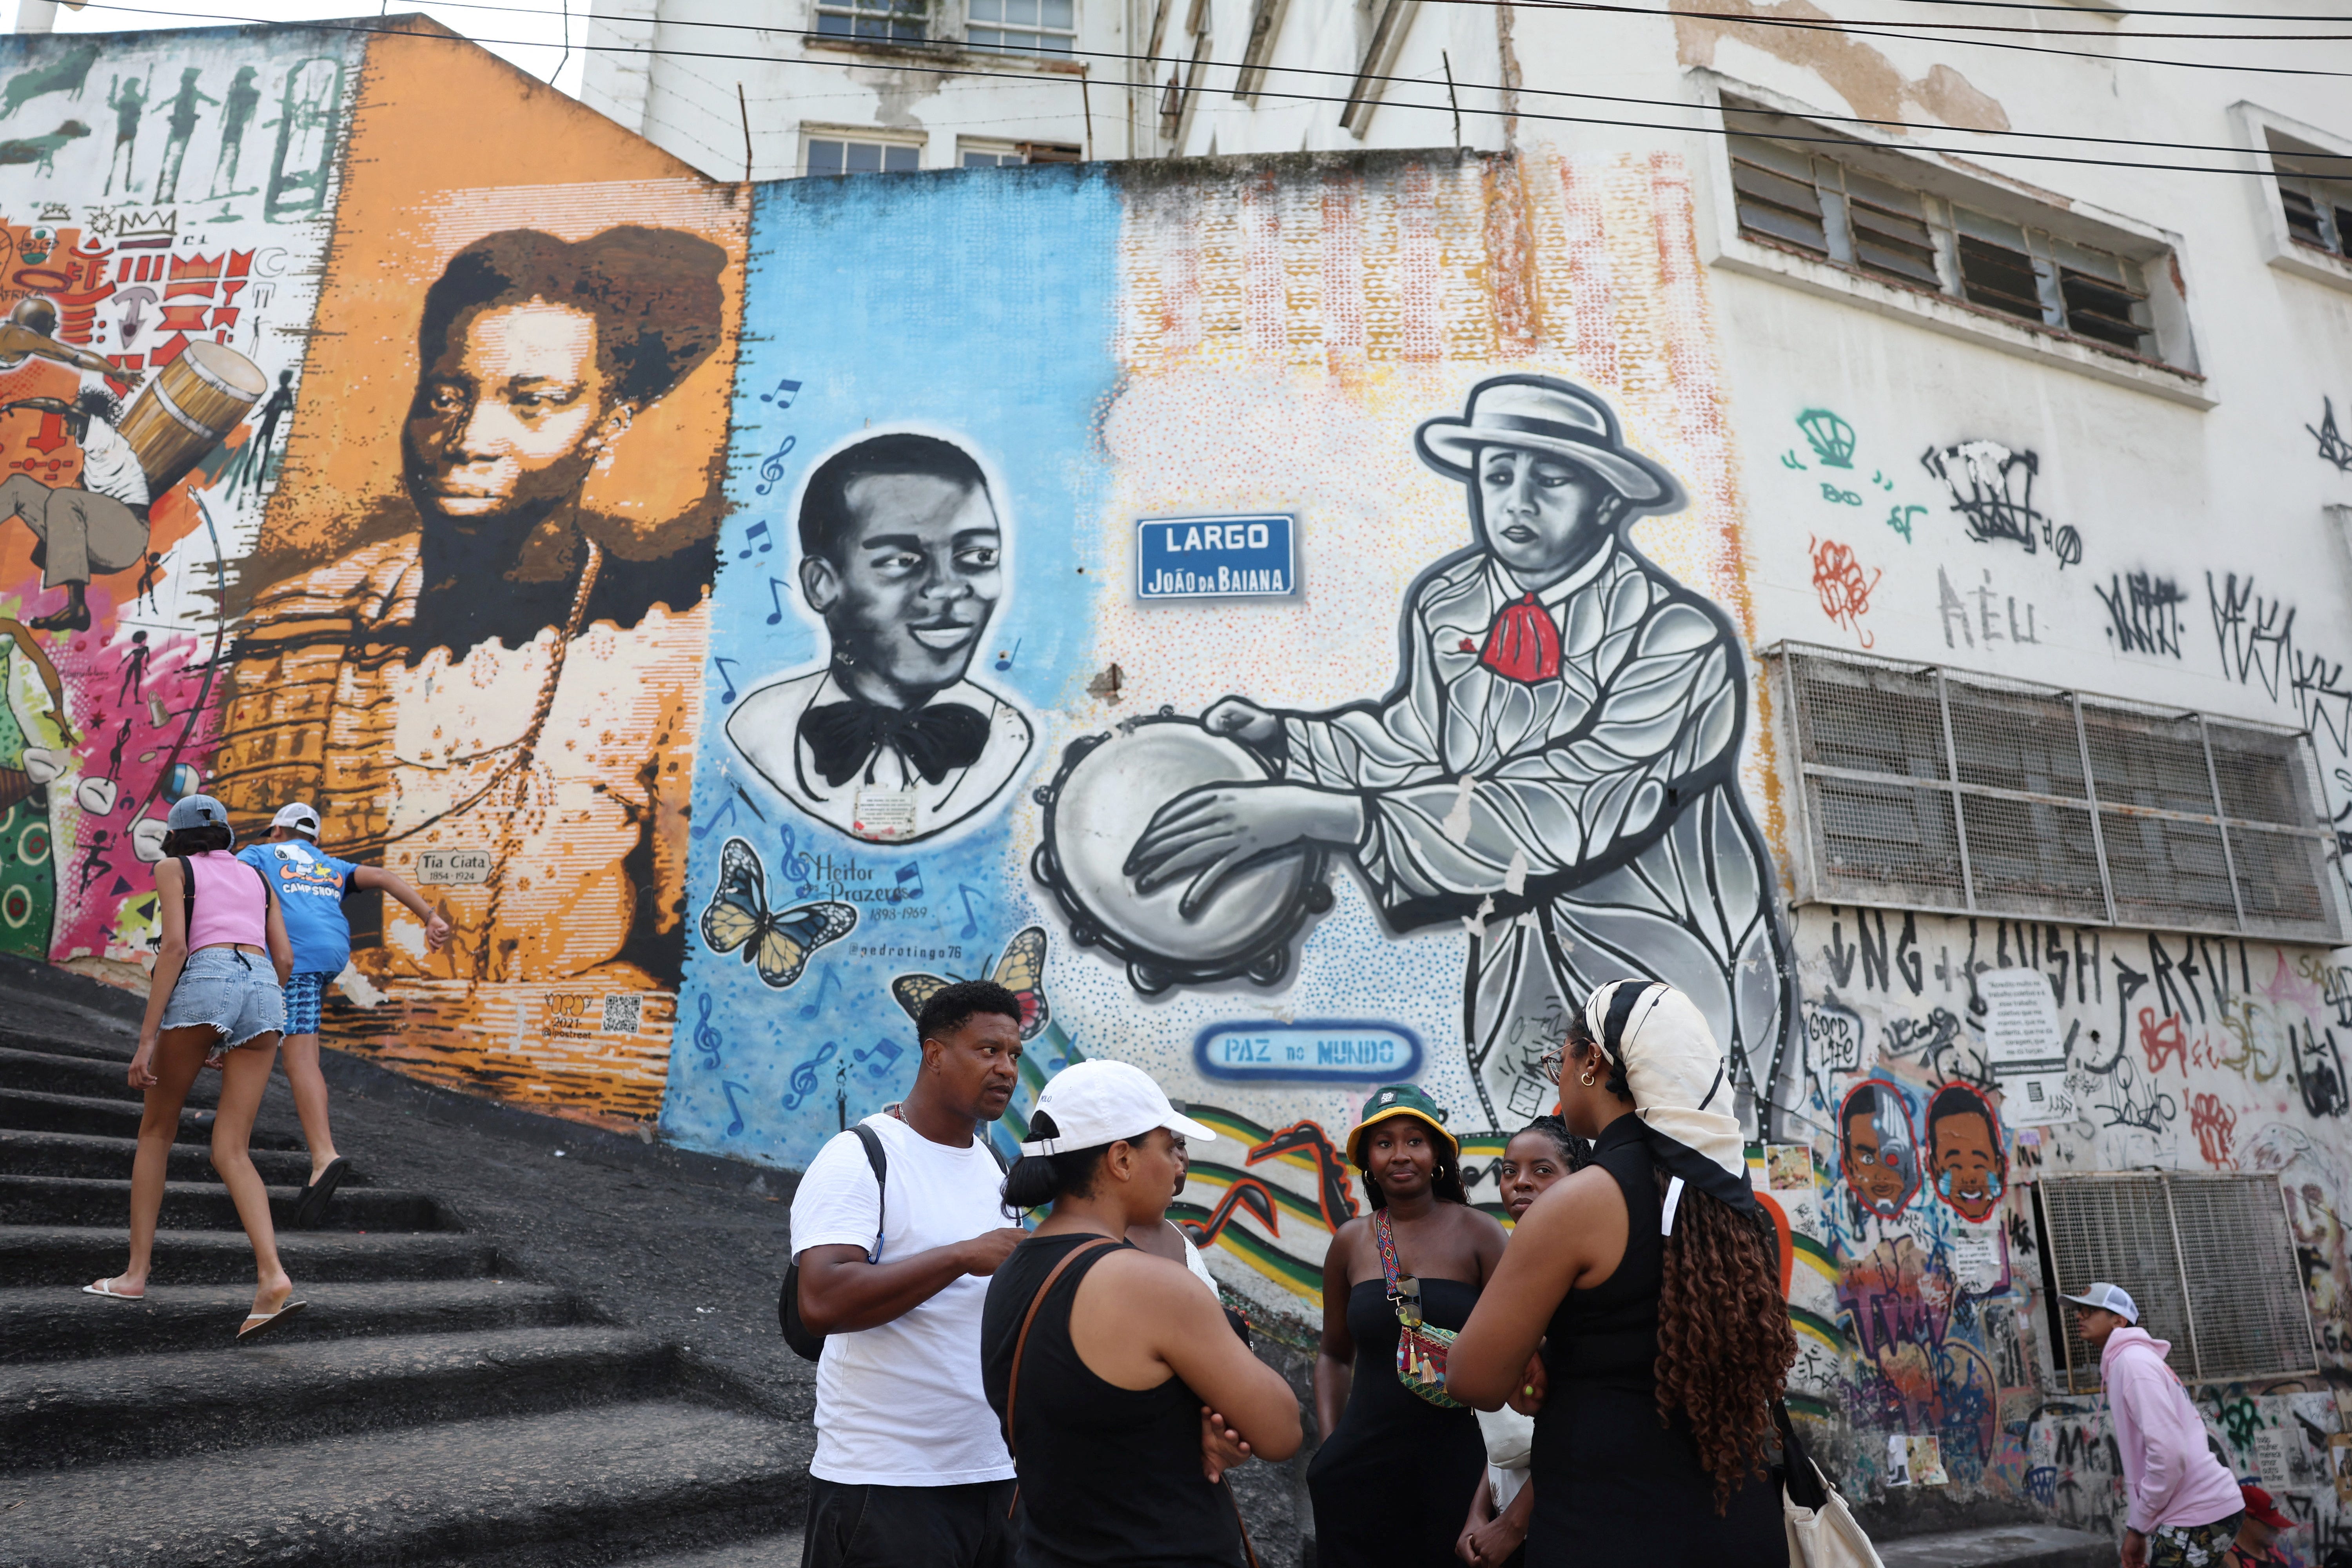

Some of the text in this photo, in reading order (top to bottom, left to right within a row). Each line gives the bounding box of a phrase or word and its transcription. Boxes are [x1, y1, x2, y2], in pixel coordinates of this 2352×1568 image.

[1166, 524, 1269, 552] LARGO
[423, 855, 485, 868] Tia Ciata
[799, 851, 874, 881] Heitor
[430, 871, 475, 880] 1854 1924
[282, 882, 341, 902] CAMP SNOP
[818, 880, 909, 902] Prazeres
[871, 907, 927, 922] 1898-1969
[1225, 1038, 1394, 1065] PAZ no MUNDO
